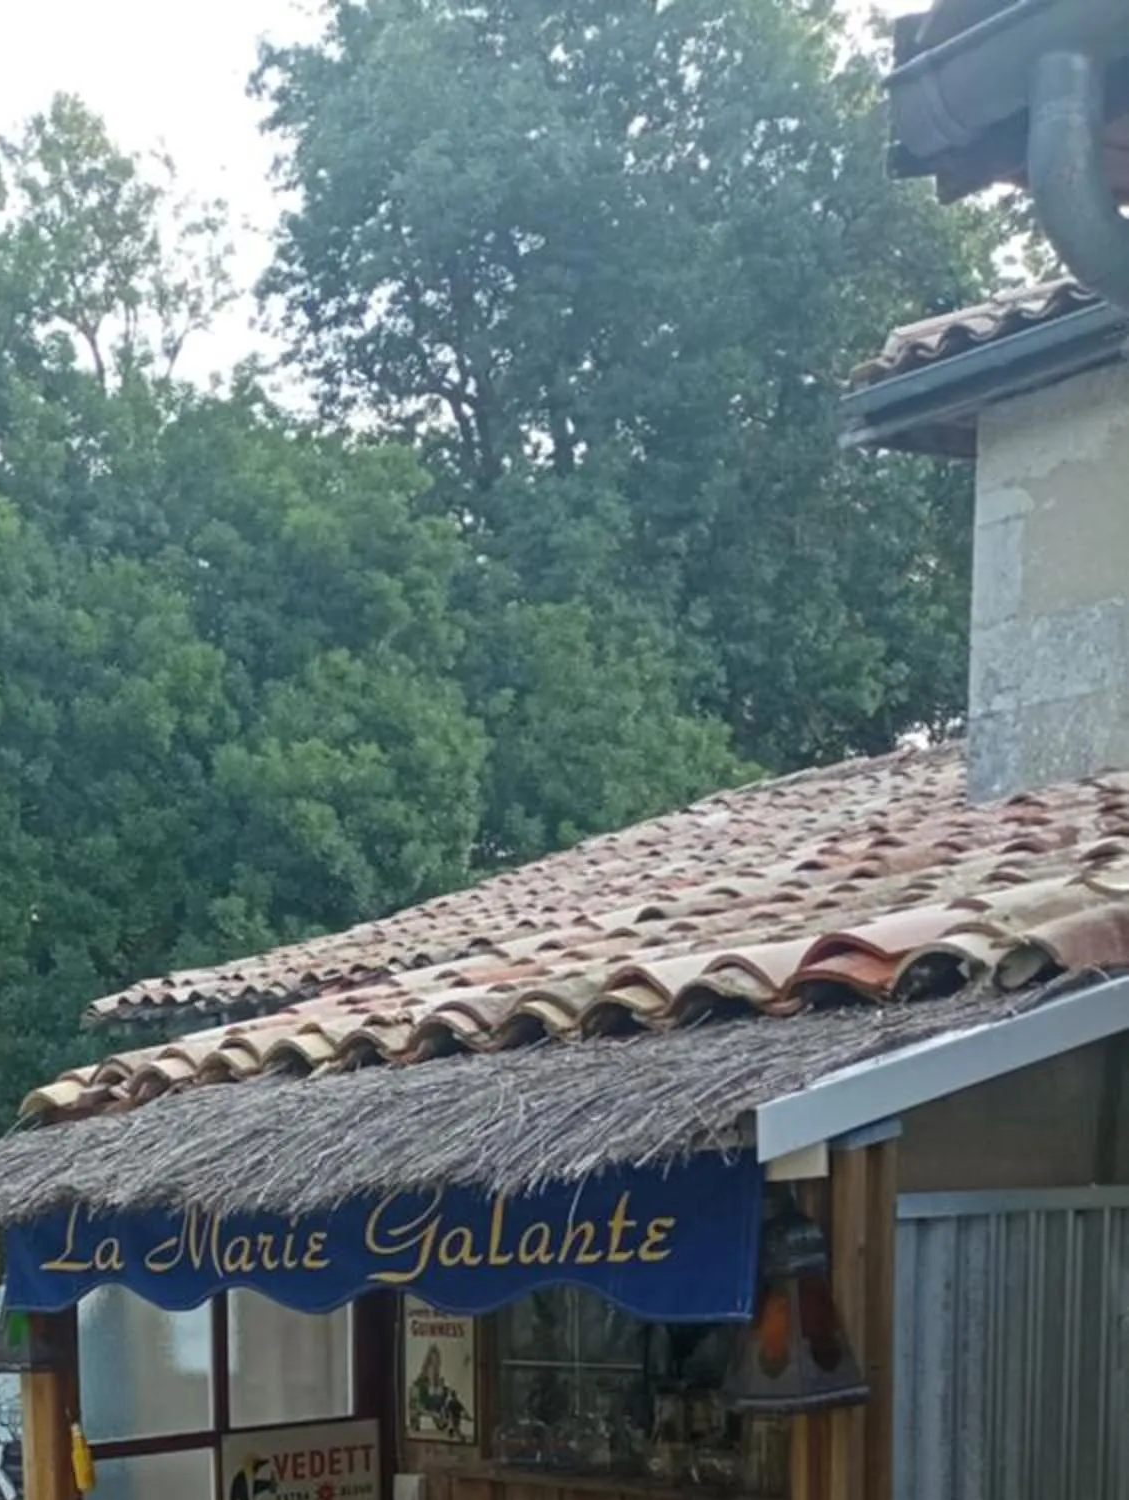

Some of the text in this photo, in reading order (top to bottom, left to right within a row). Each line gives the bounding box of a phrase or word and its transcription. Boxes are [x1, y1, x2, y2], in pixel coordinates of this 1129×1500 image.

[39, 1200, 125, 1271] La
[411, 1319, 465, 1338] GUINNESS
[272, 1444, 375, 1482] VEDETT
